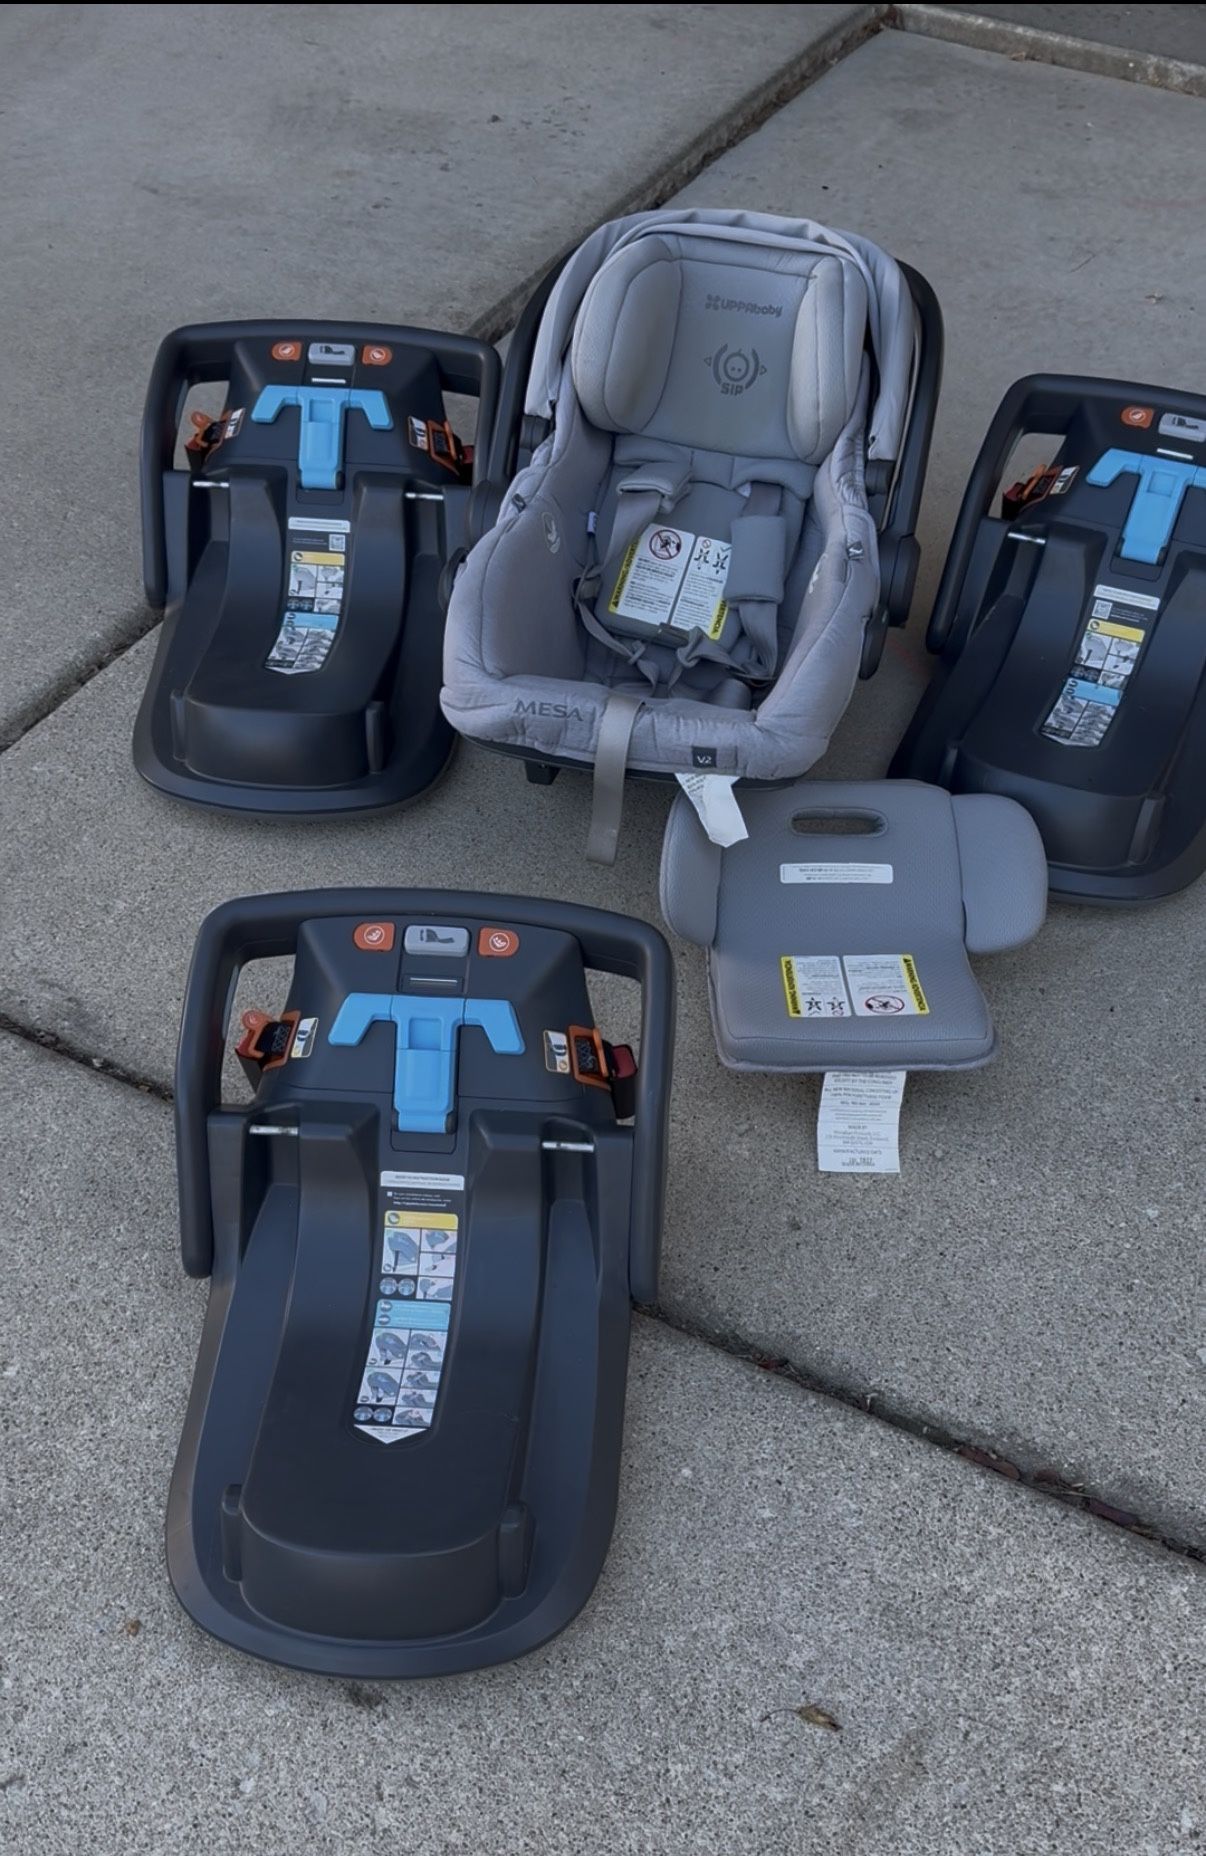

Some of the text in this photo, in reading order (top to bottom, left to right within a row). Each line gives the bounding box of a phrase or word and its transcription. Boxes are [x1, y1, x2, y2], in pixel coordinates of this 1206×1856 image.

[721, 298, 783, 318] UPPAbaby
[720, 382, 744, 396] SIP
[513, 698, 584, 722] MESA
[696, 755, 713, 765] V2
